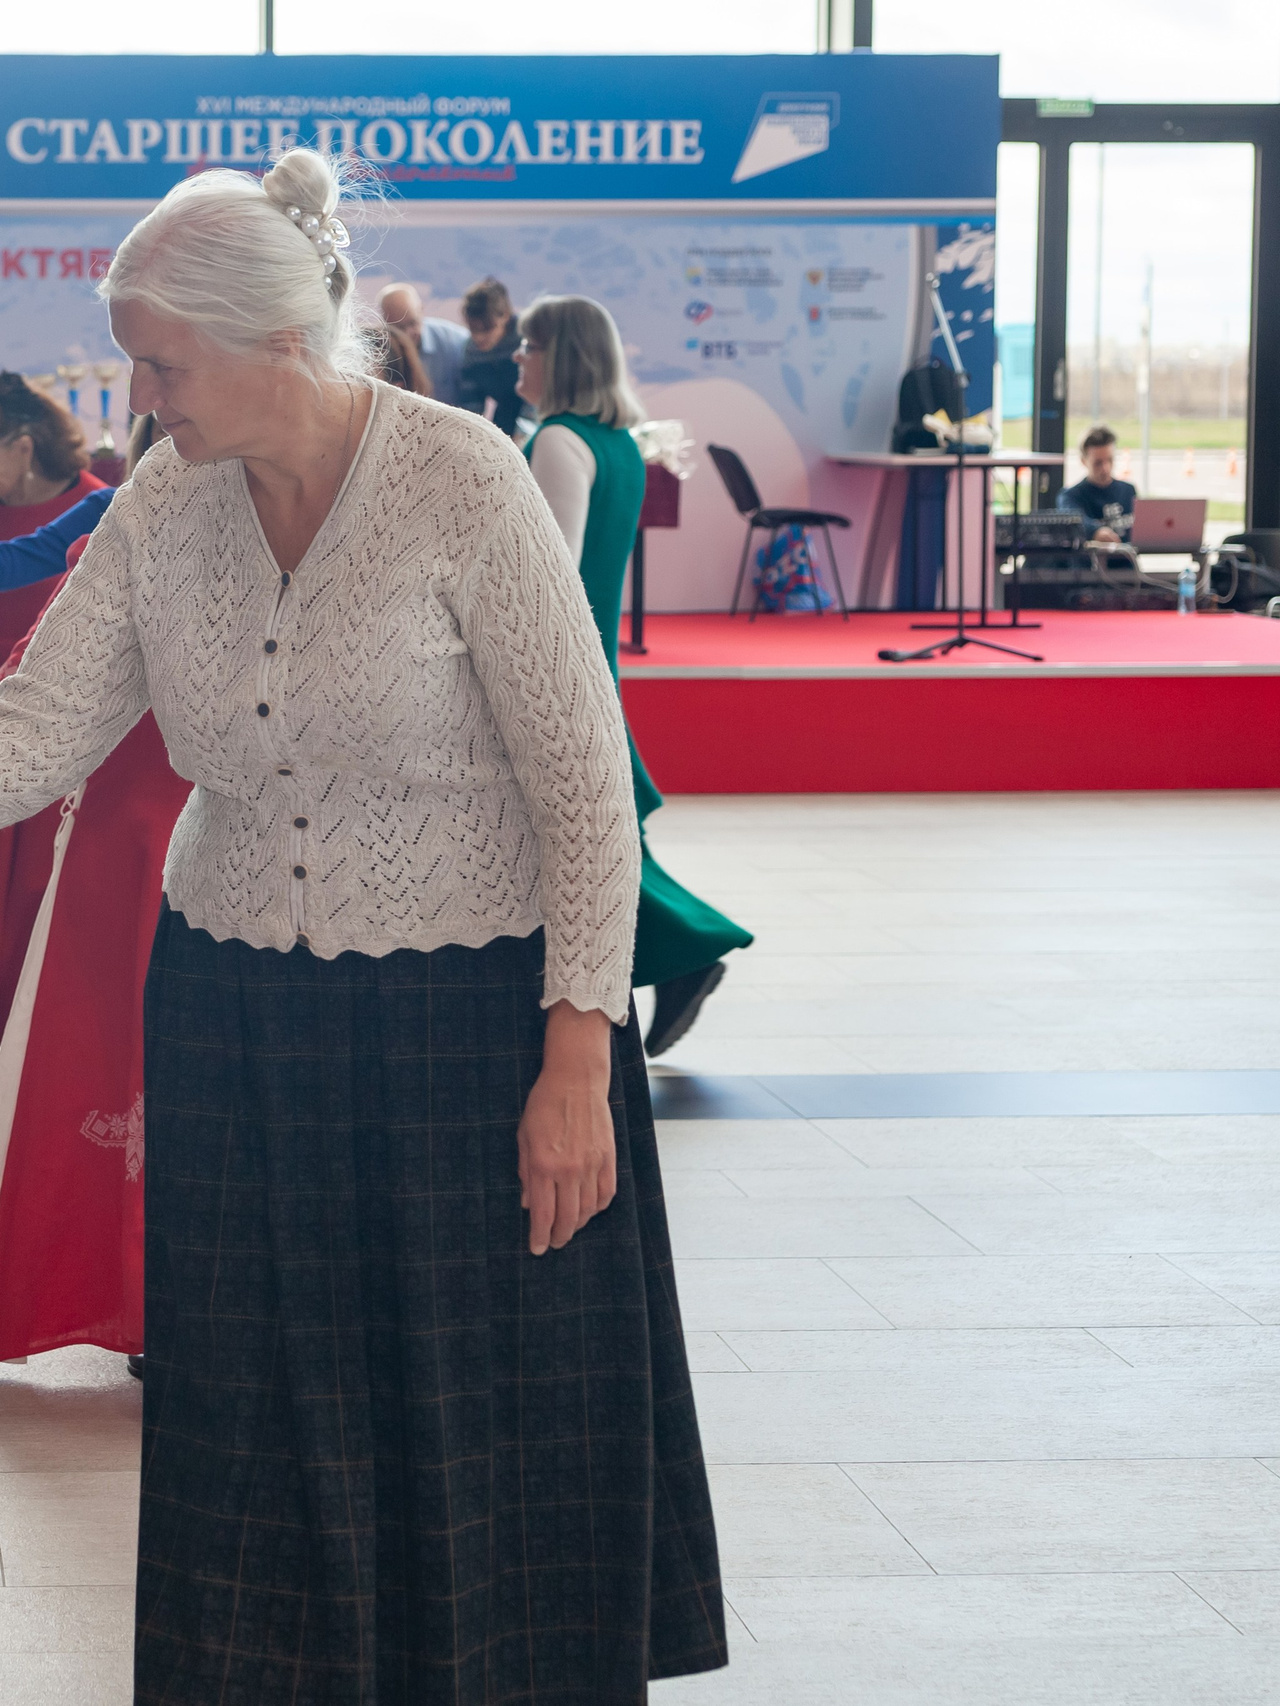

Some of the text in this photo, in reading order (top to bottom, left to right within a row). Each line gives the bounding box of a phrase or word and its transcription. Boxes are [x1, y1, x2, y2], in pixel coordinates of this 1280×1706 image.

[195, 93, 512, 117] XVI МЕЖДУНАРОДНЫЙ ФОРУМ
[5, 117, 706, 166] СТАРШЕЕ ПОКОЛЕНИЕ
